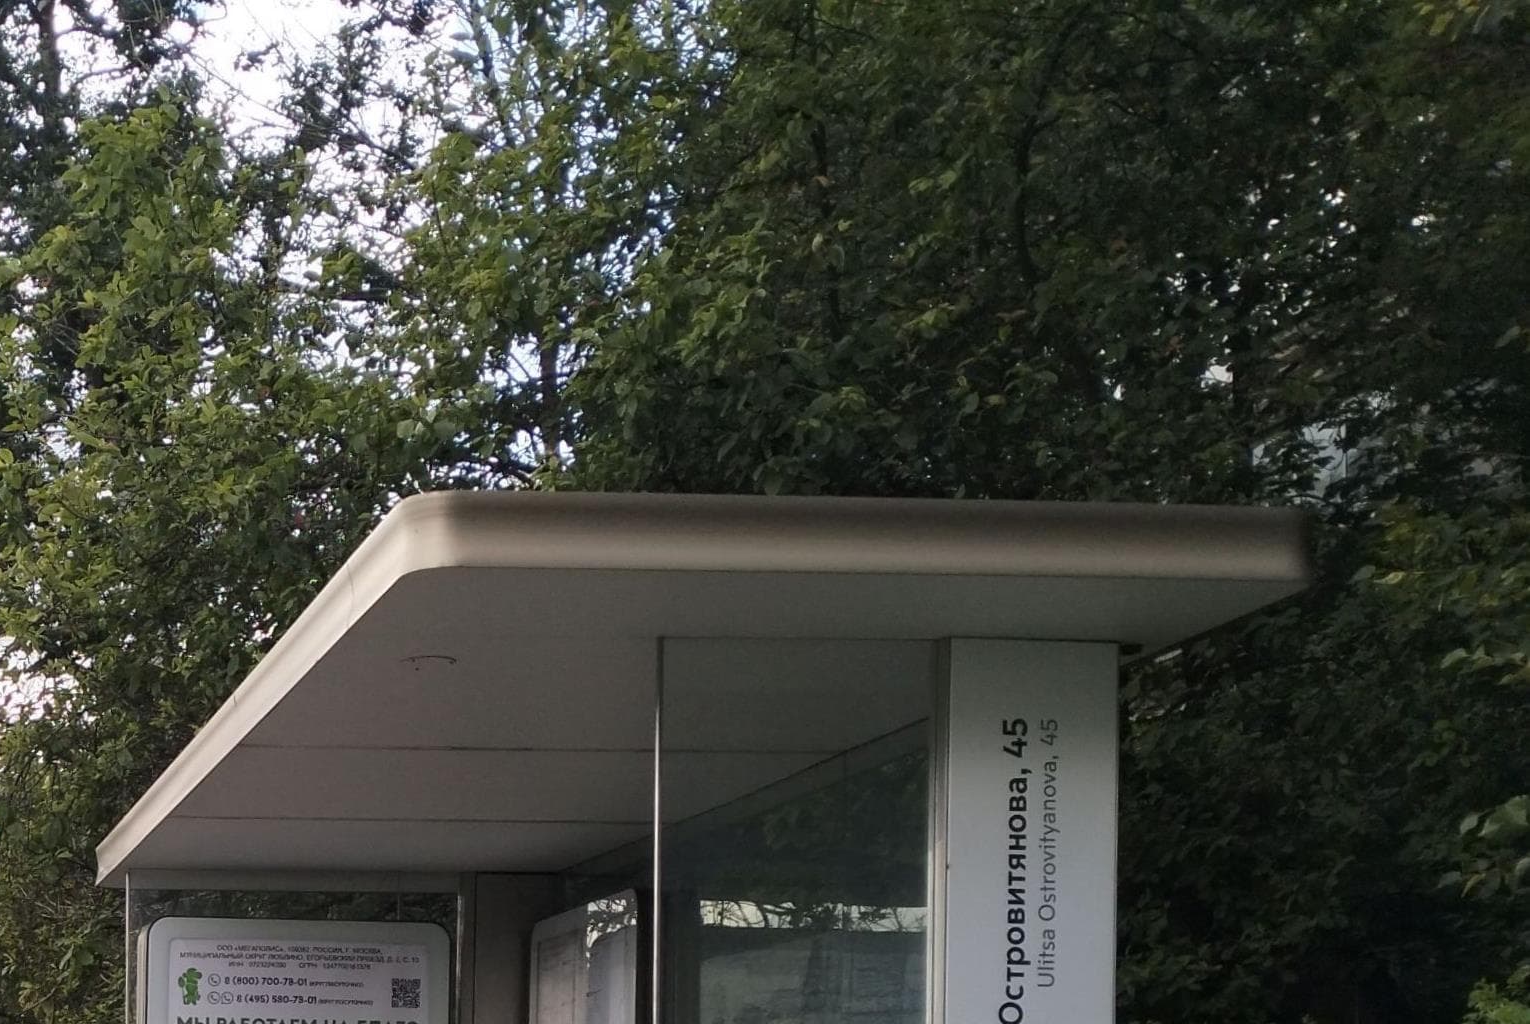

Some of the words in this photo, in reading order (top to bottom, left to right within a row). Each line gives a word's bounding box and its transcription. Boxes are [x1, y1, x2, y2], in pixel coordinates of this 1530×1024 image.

[1002, 716, 1029, 758] 45
[1039, 718, 1058, 747] 45
[1037, 754, 1061, 922] Ostrovityanova,
[1037, 927, 1056, 988] Ulitsa
[232, 976, 259, 986] (800)
[244, 994, 270, 1004] (495)
